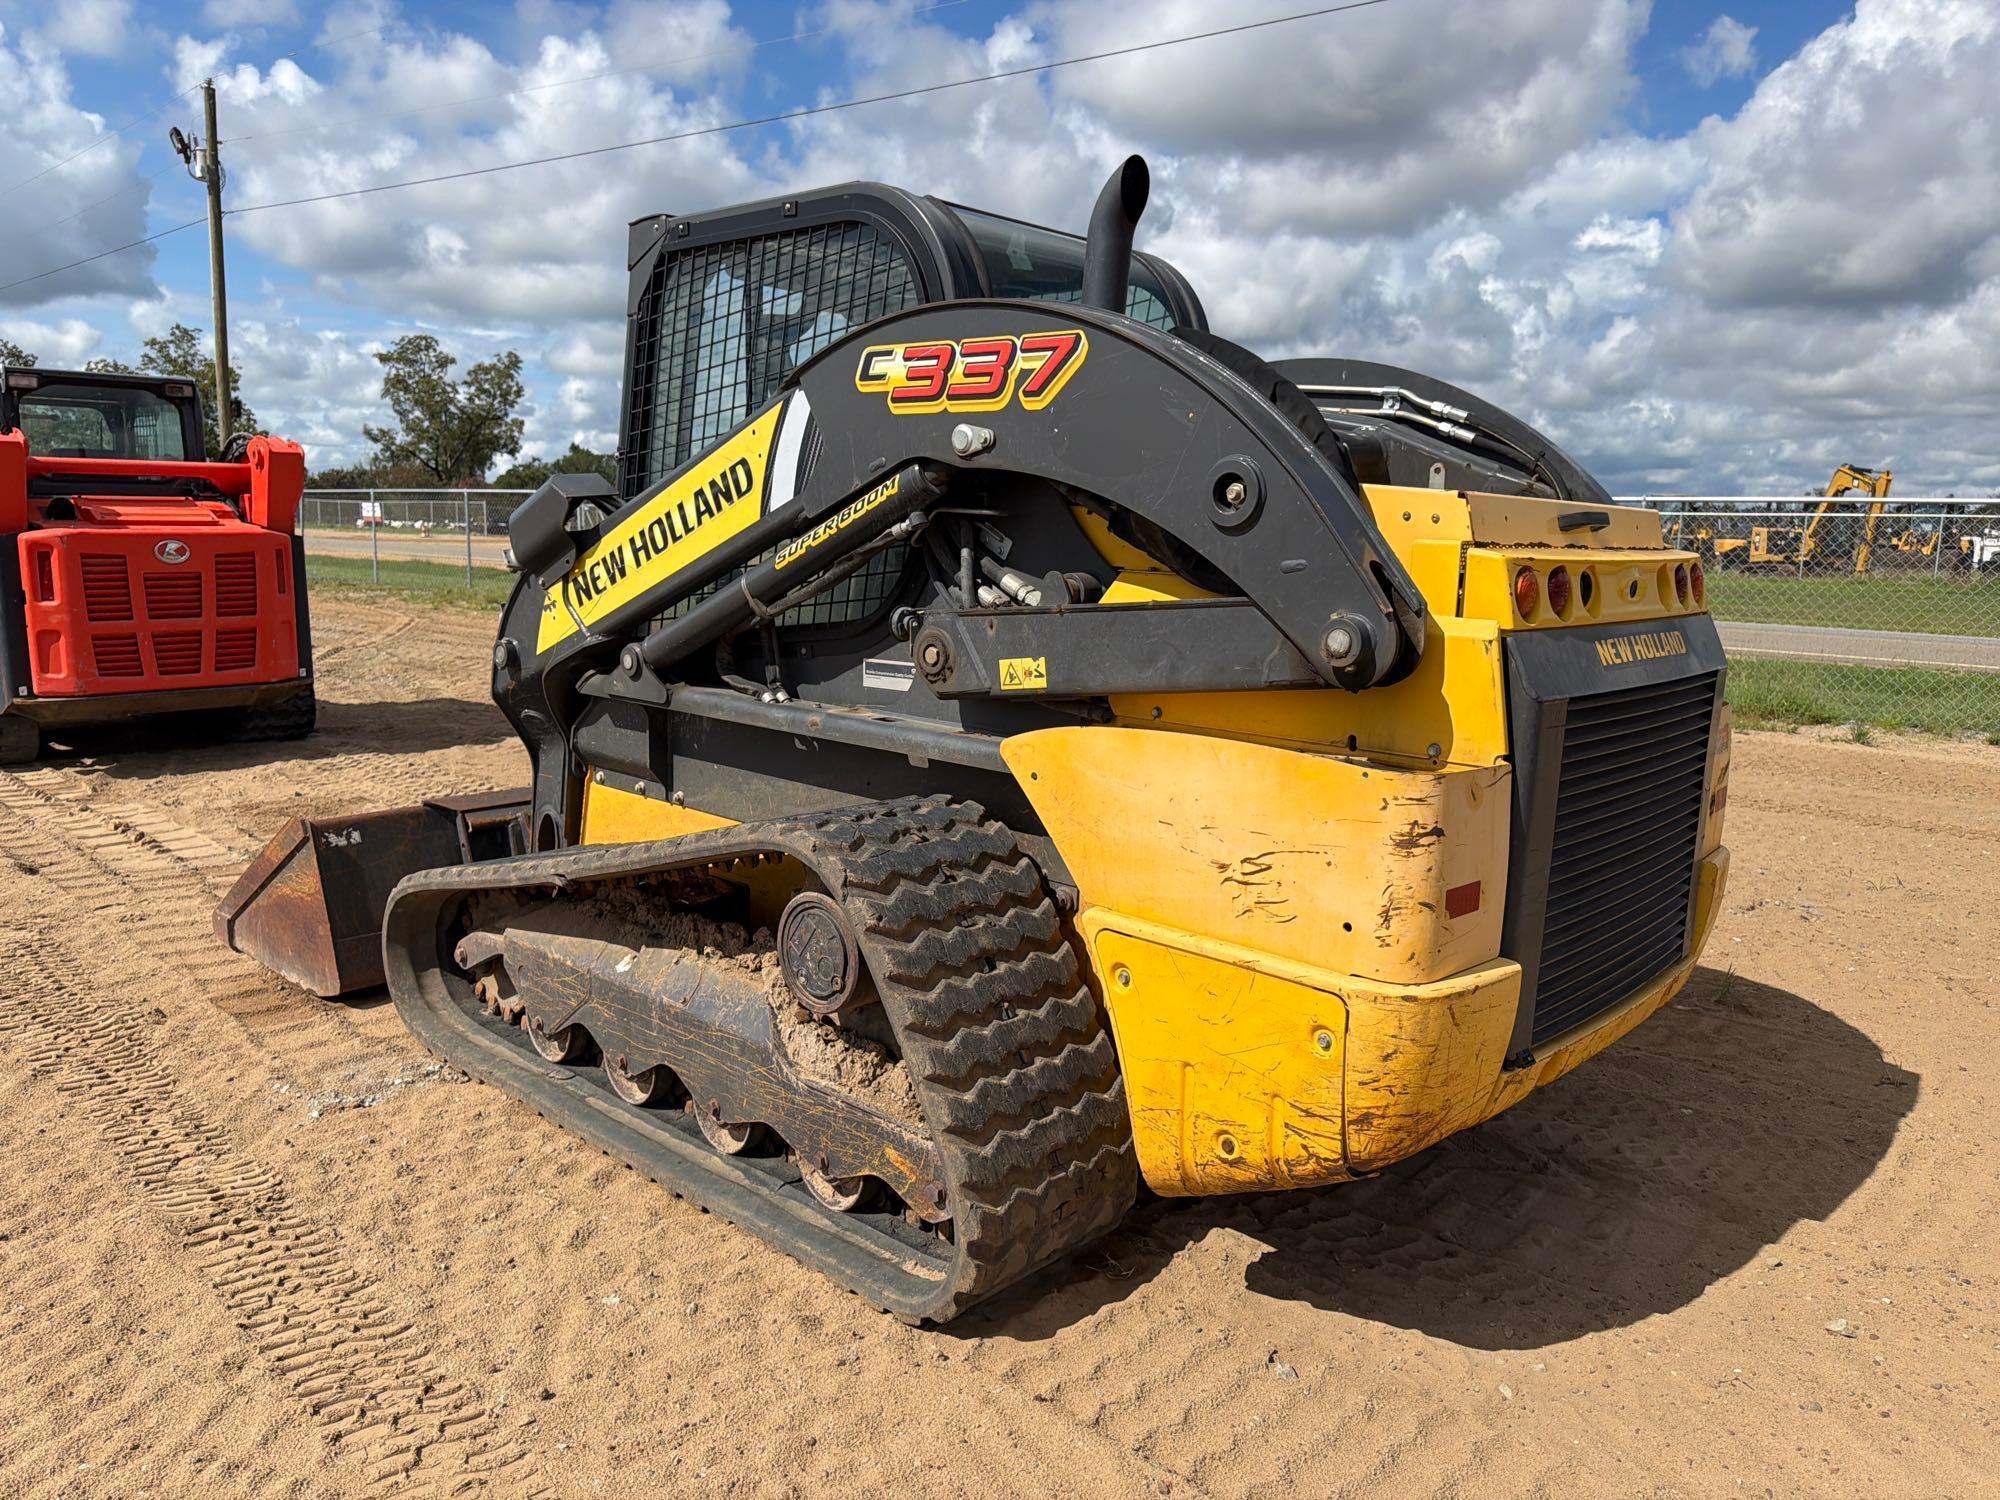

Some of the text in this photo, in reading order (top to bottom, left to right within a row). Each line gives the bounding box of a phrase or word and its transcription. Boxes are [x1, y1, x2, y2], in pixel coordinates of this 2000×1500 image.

[857, 331, 1086, 410] C337
[572, 457, 754, 607] NEW HOLLAND
[775, 473, 900, 569] SUPER BOOM
[1594, 631, 1687, 666] NEW HOLLAND
